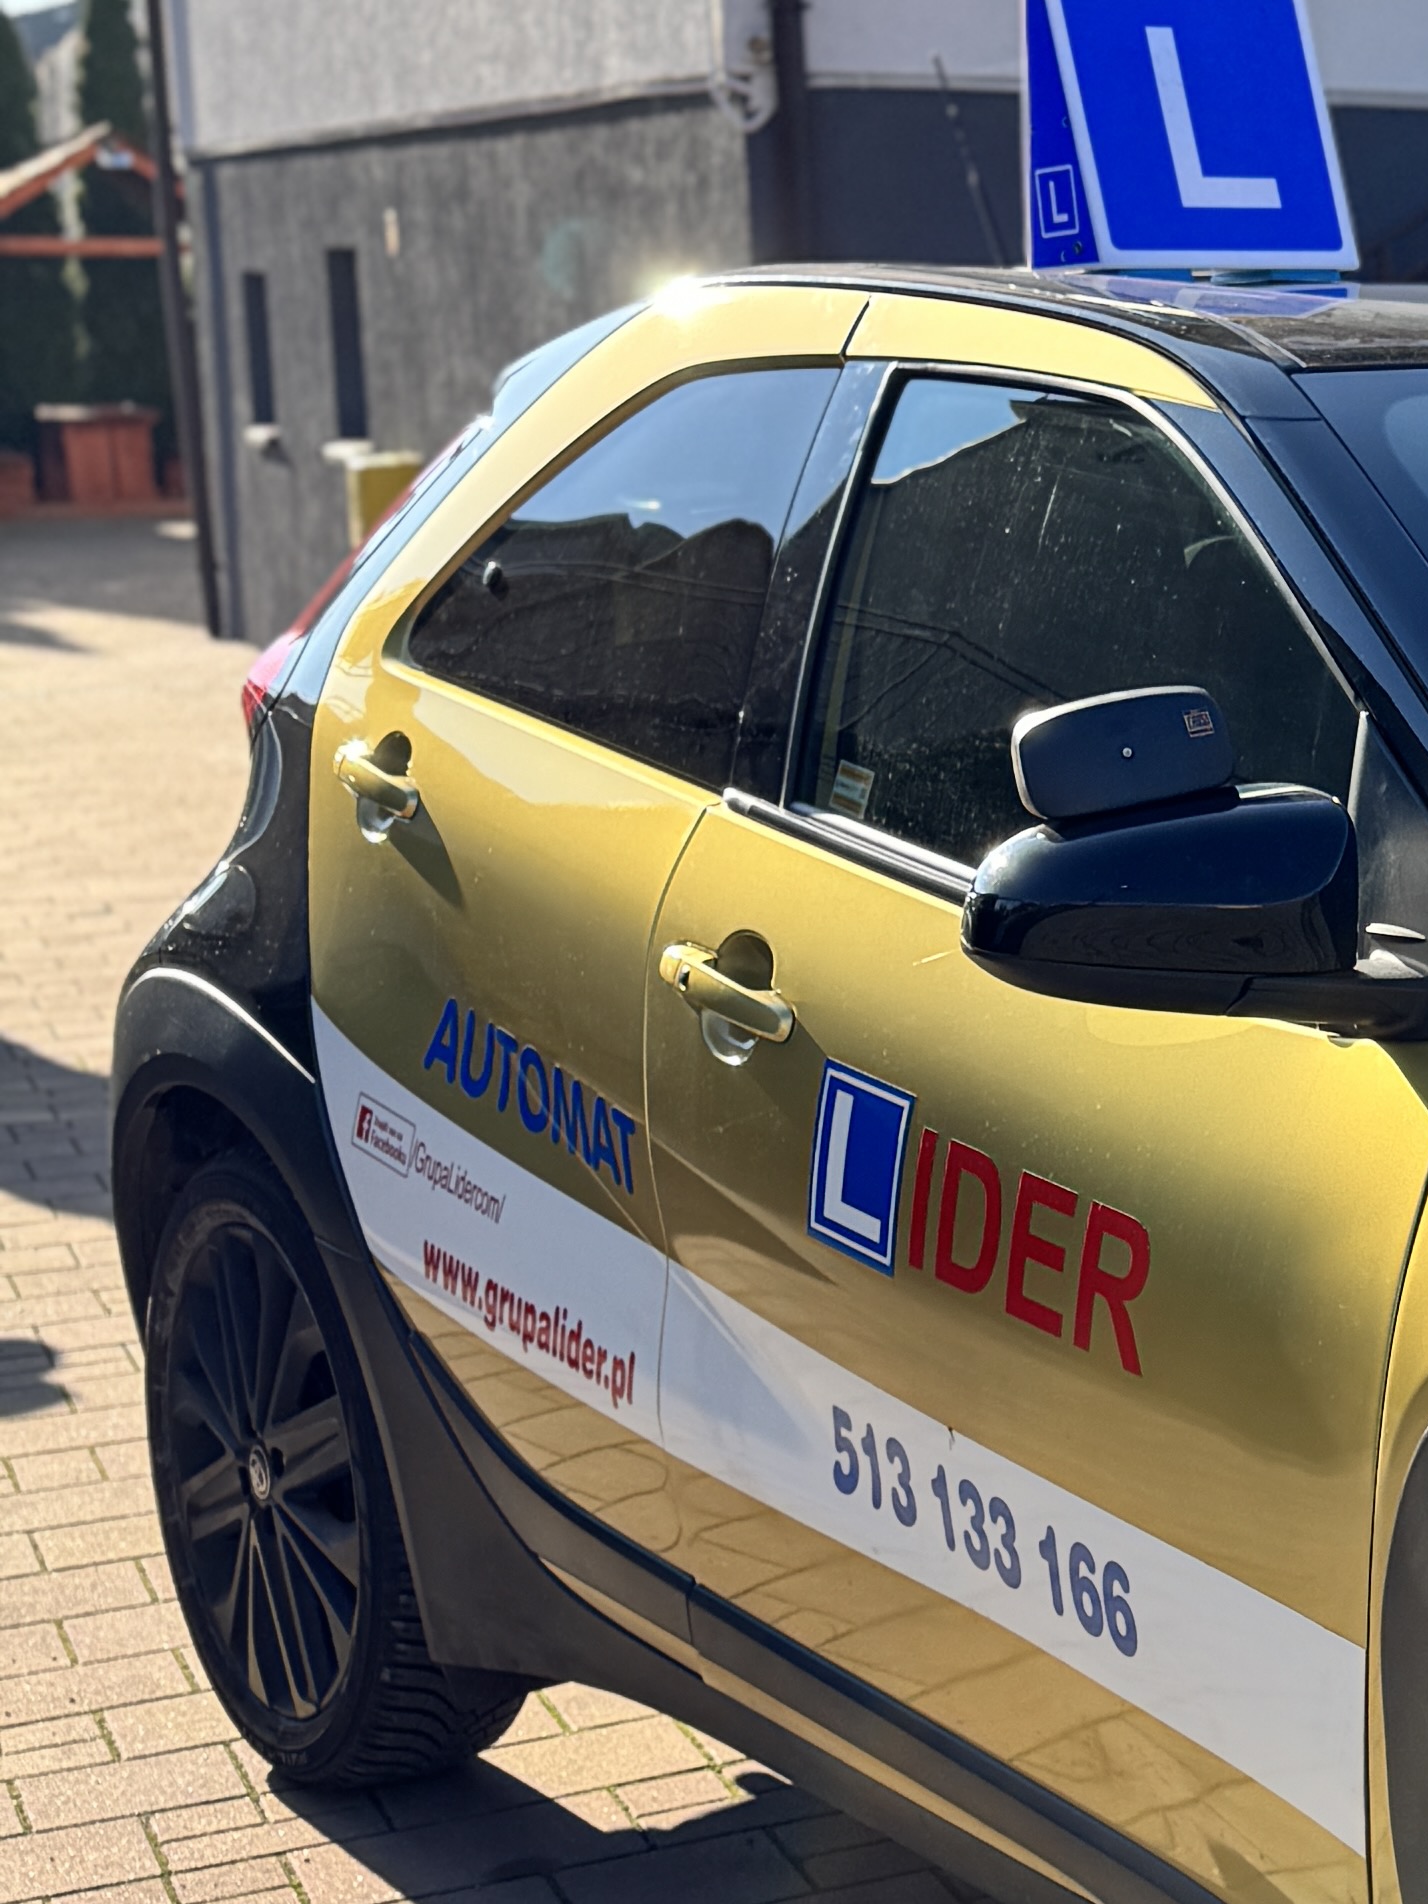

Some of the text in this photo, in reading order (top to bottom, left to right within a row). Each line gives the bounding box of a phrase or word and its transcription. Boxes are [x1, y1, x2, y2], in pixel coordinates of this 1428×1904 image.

[1048, 180, 1069, 224] L
[1145, 26, 1282, 208] L
[424, 997, 634, 1196] AUTOMAT
[422, 1239, 634, 1409] www.grupalider.pl
[832, 1406, 1138, 1658] 513 133 166
